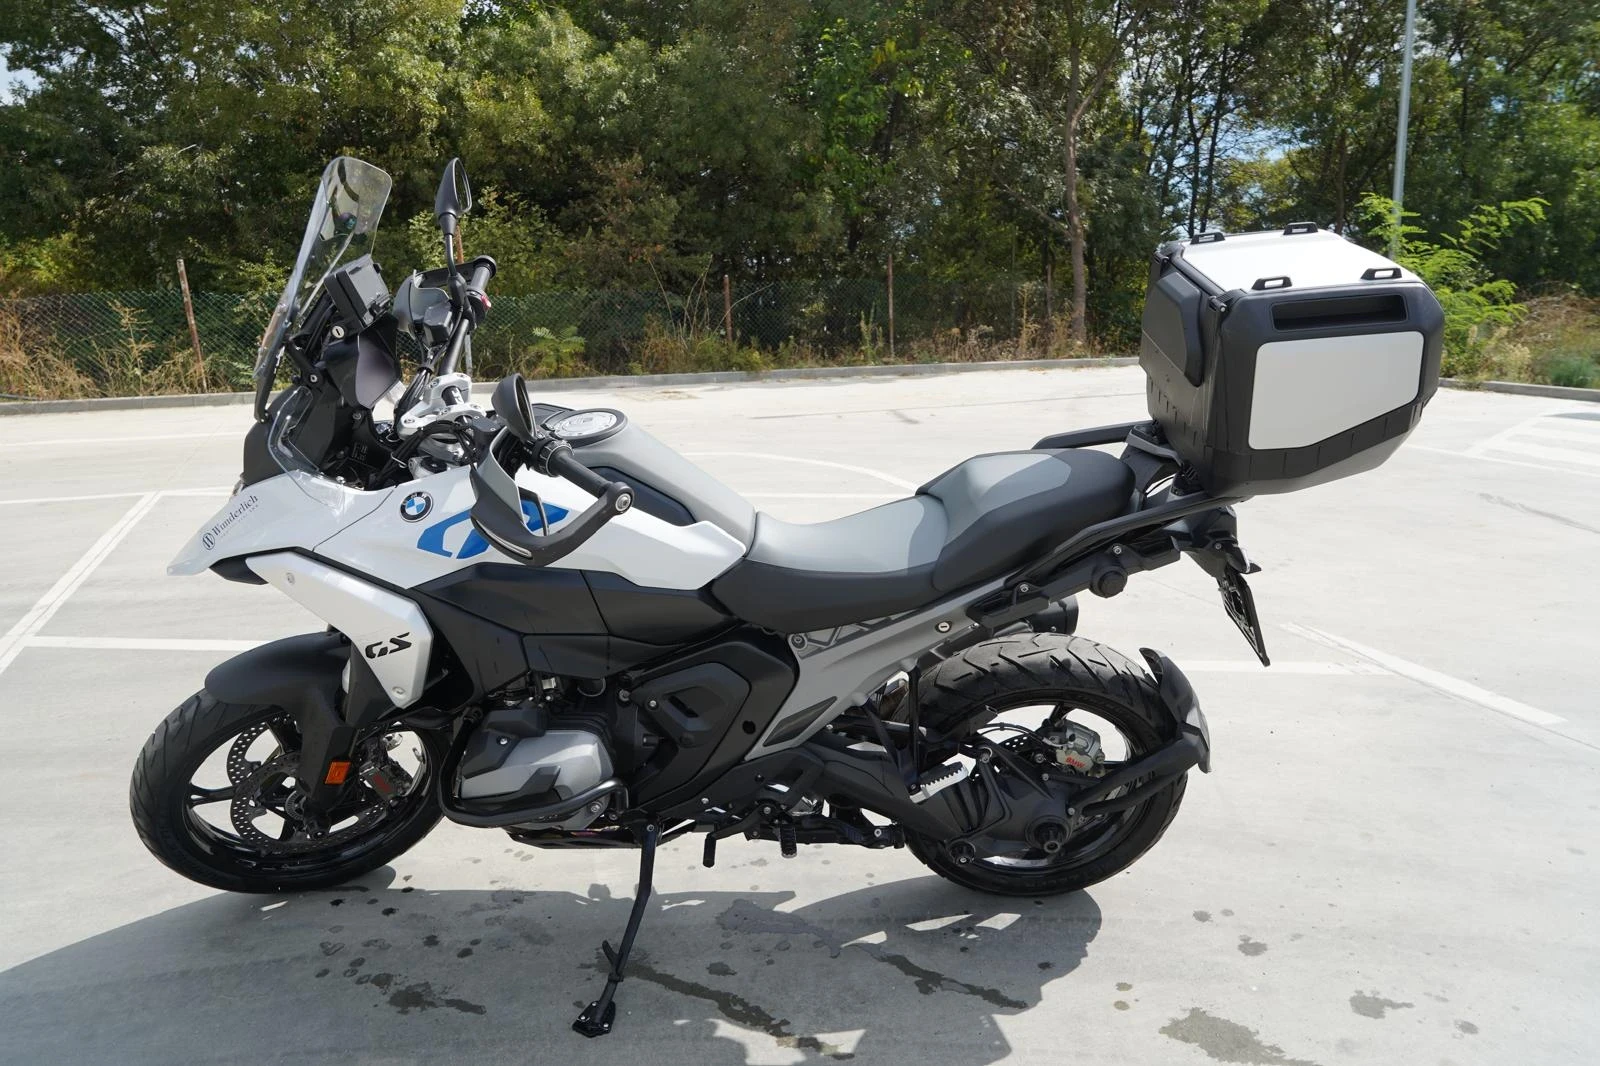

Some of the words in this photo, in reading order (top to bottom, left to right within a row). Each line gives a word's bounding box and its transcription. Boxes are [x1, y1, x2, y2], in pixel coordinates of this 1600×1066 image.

[211, 495, 258, 536] Wunderlich
[365, 632, 412, 659] GS
[1065, 756, 1087, 768] BMW
